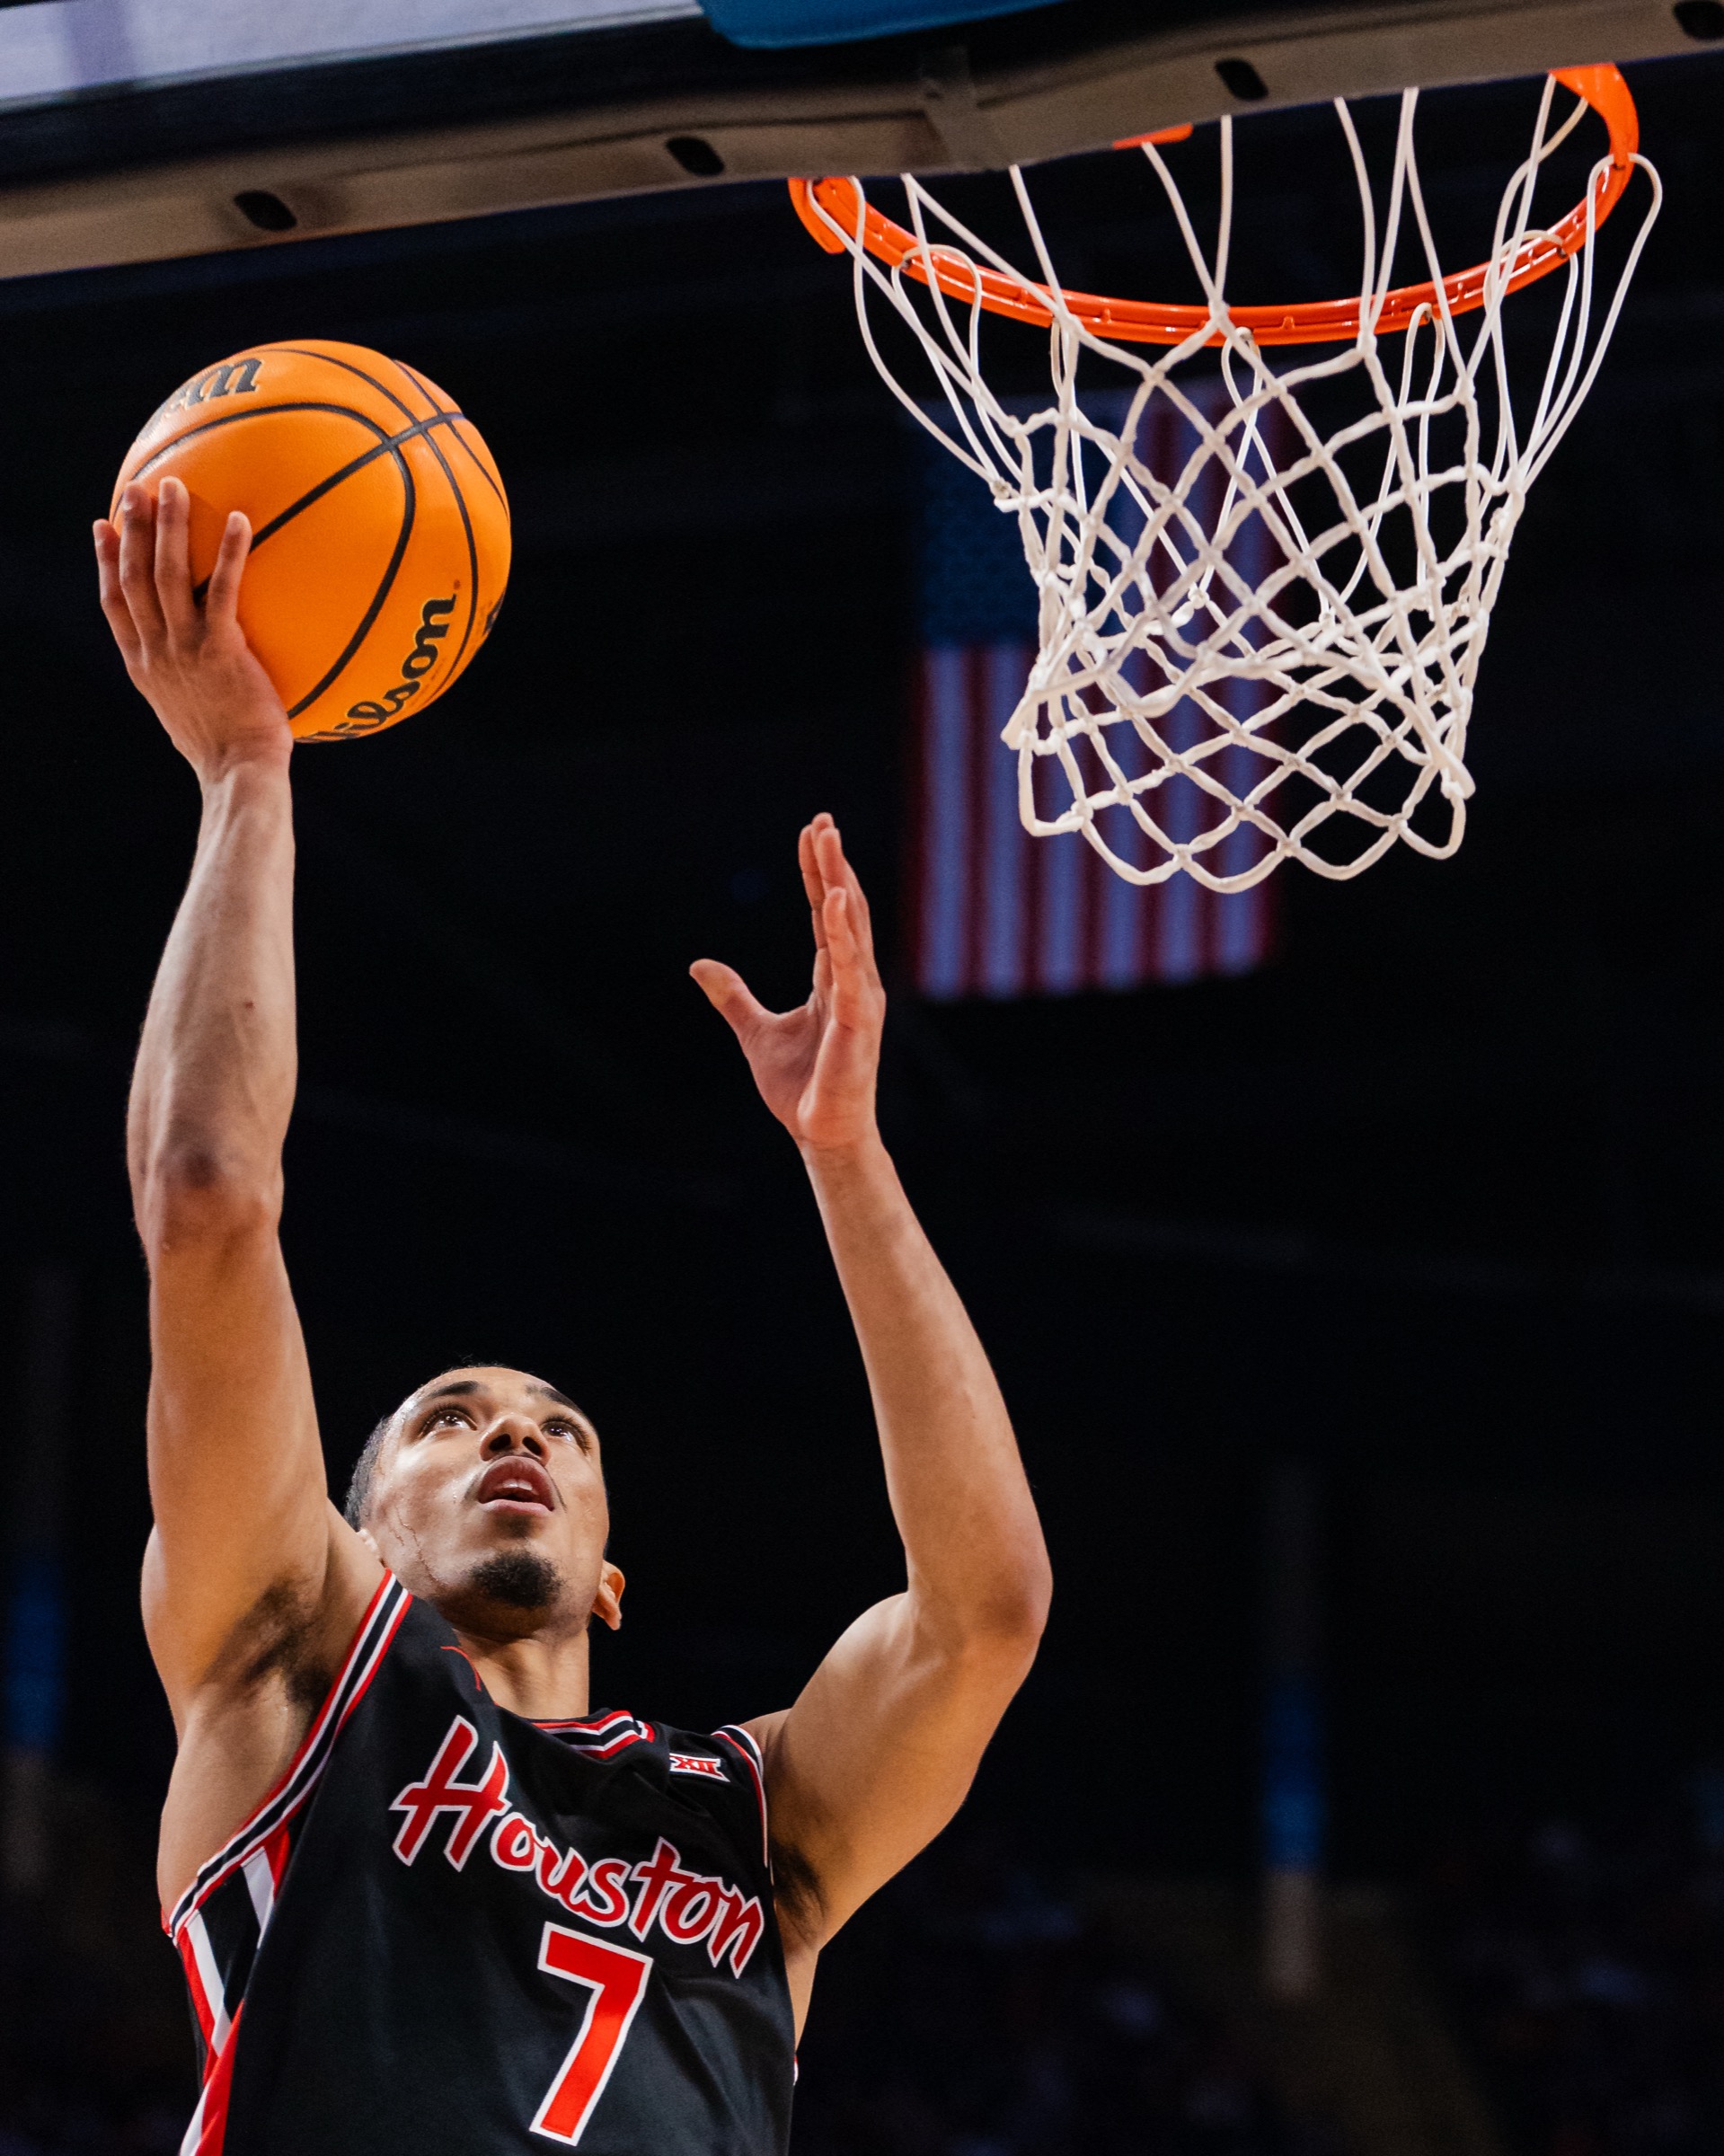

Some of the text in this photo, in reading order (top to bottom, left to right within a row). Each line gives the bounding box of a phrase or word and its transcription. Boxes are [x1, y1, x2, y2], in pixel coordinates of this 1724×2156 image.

[295, 593, 456, 743] ilson
[389, 1715, 765, 1979] Houston
[669, 1753, 729, 1781] XII
[529, 1922, 653, 2146] 7
